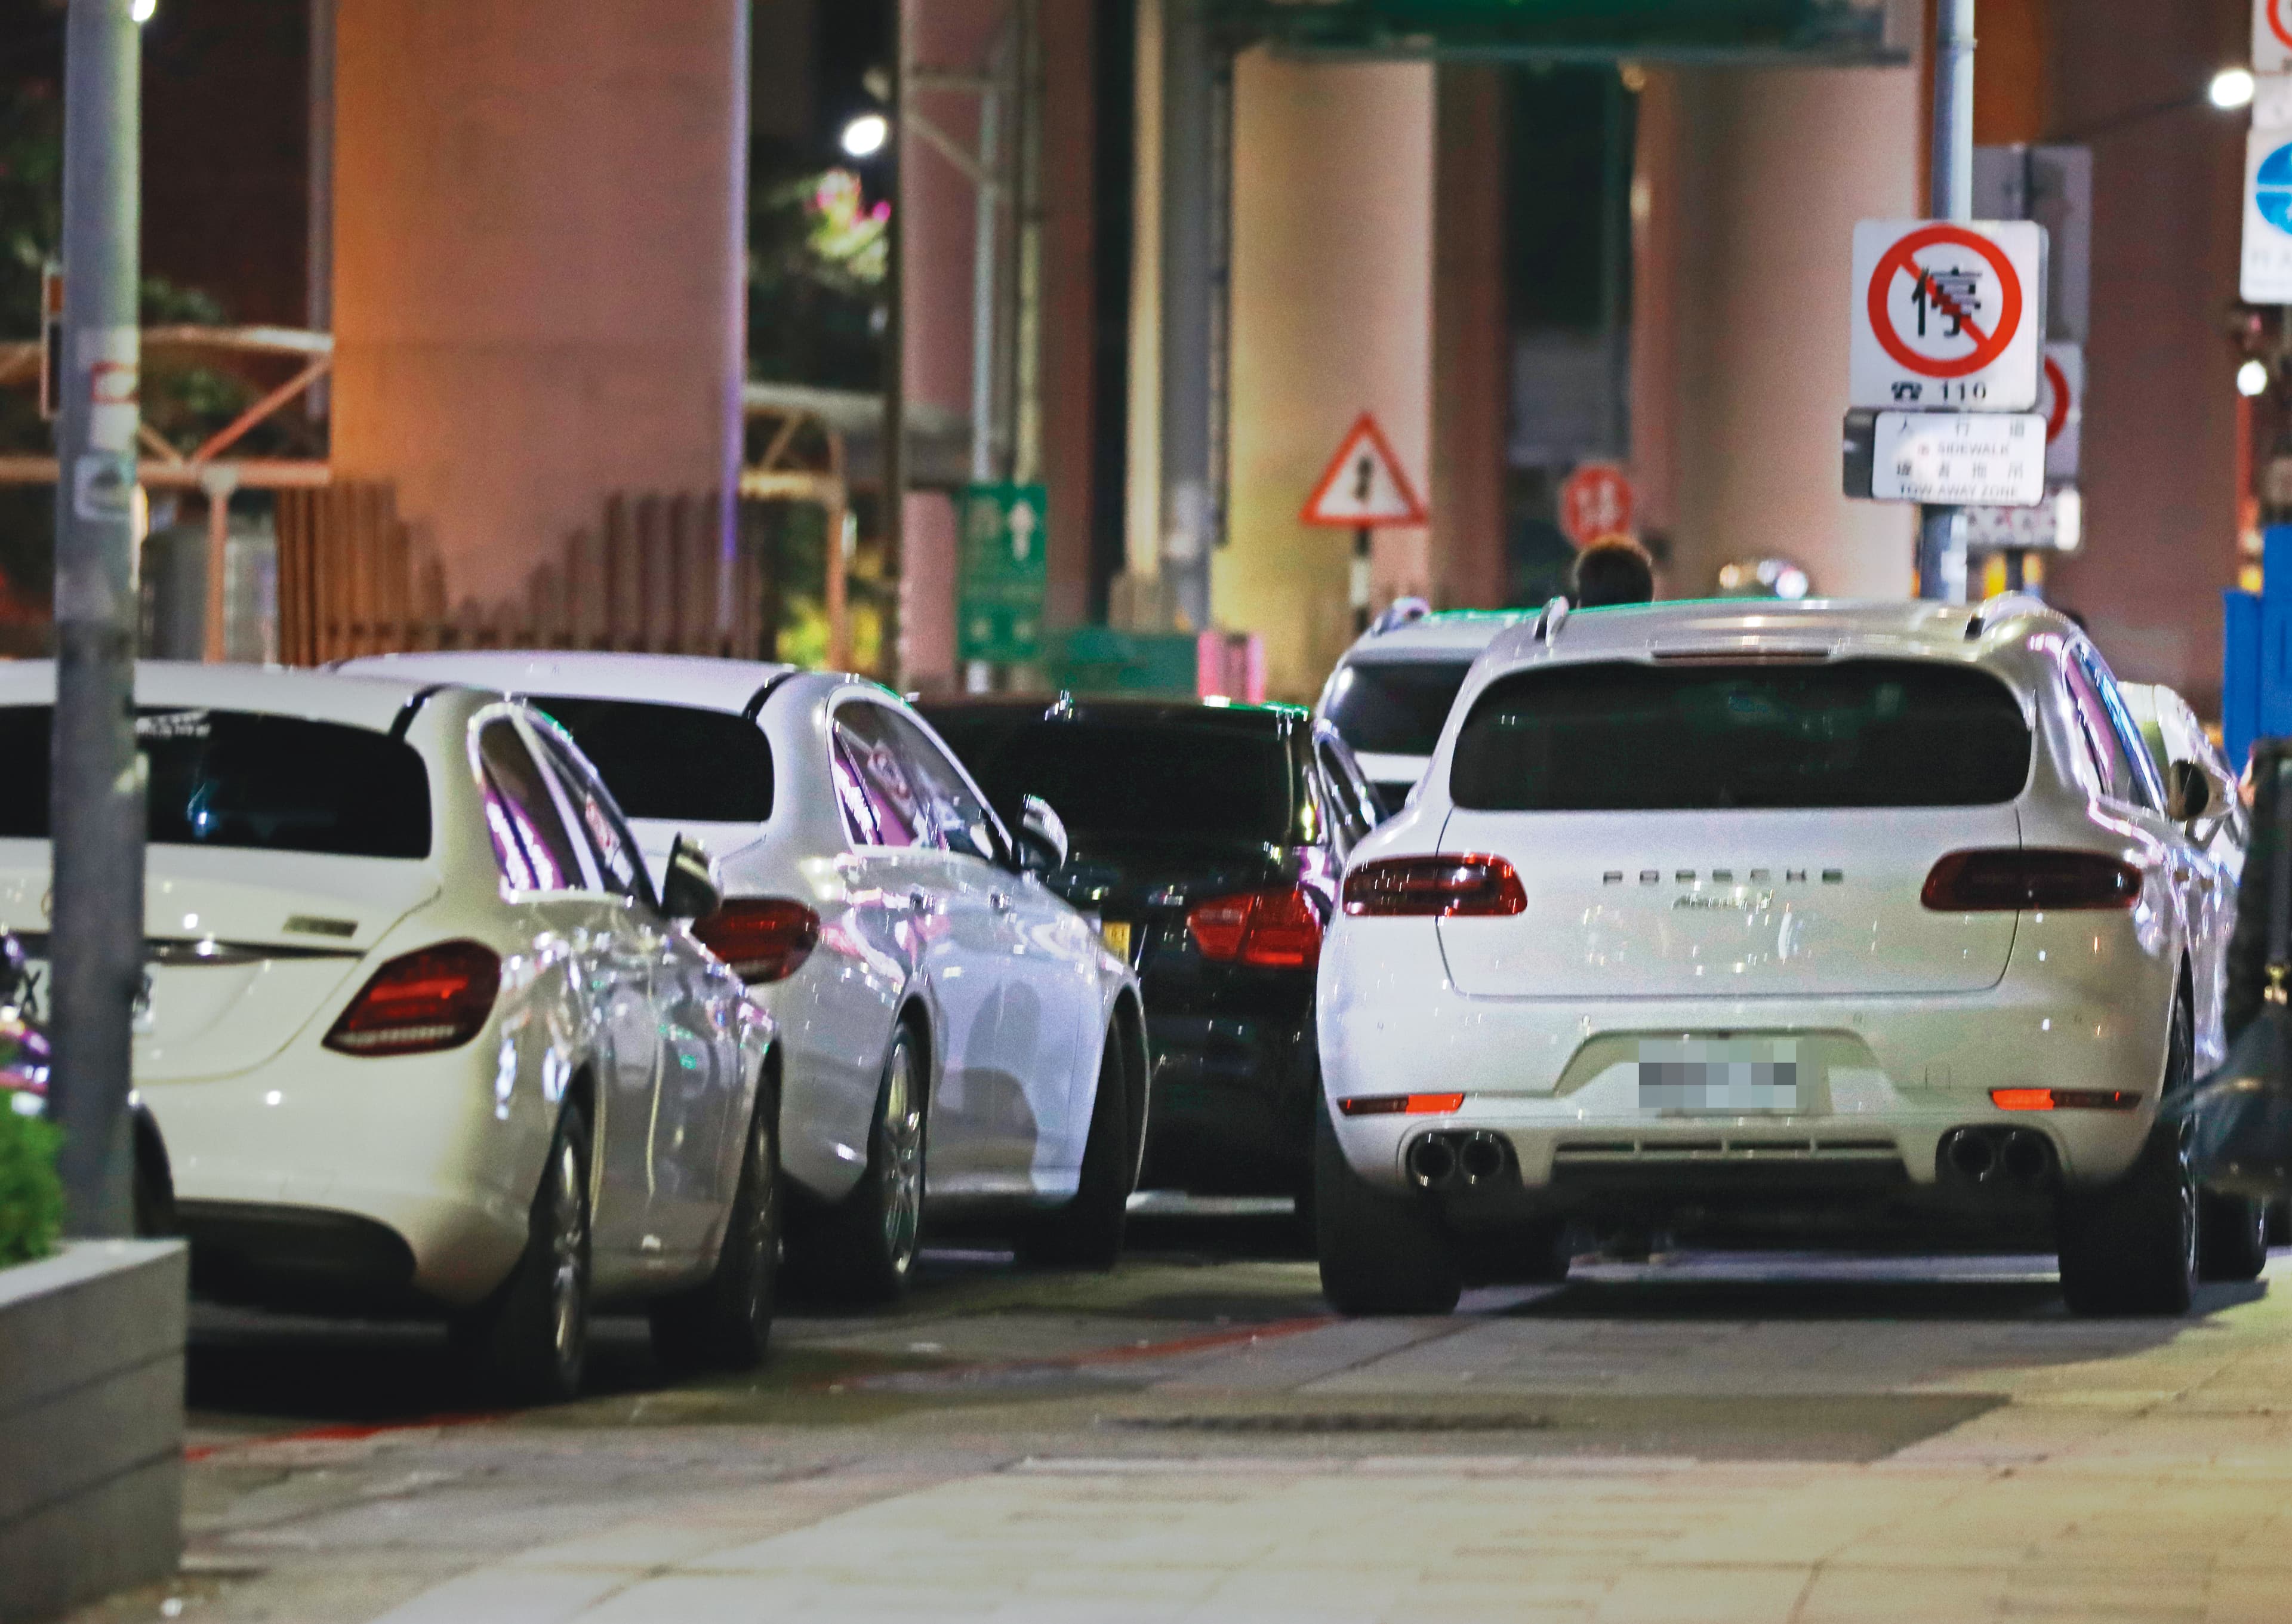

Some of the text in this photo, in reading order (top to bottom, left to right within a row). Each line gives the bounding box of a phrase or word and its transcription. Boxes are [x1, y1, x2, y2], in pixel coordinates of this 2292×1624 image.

[1940, 381, 1986, 400] 110
[1937, 443, 2009, 455] SIDEWALK
[1938, 485, 1977, 497] AWAY
[1982, 485, 2017, 497] ZONE
